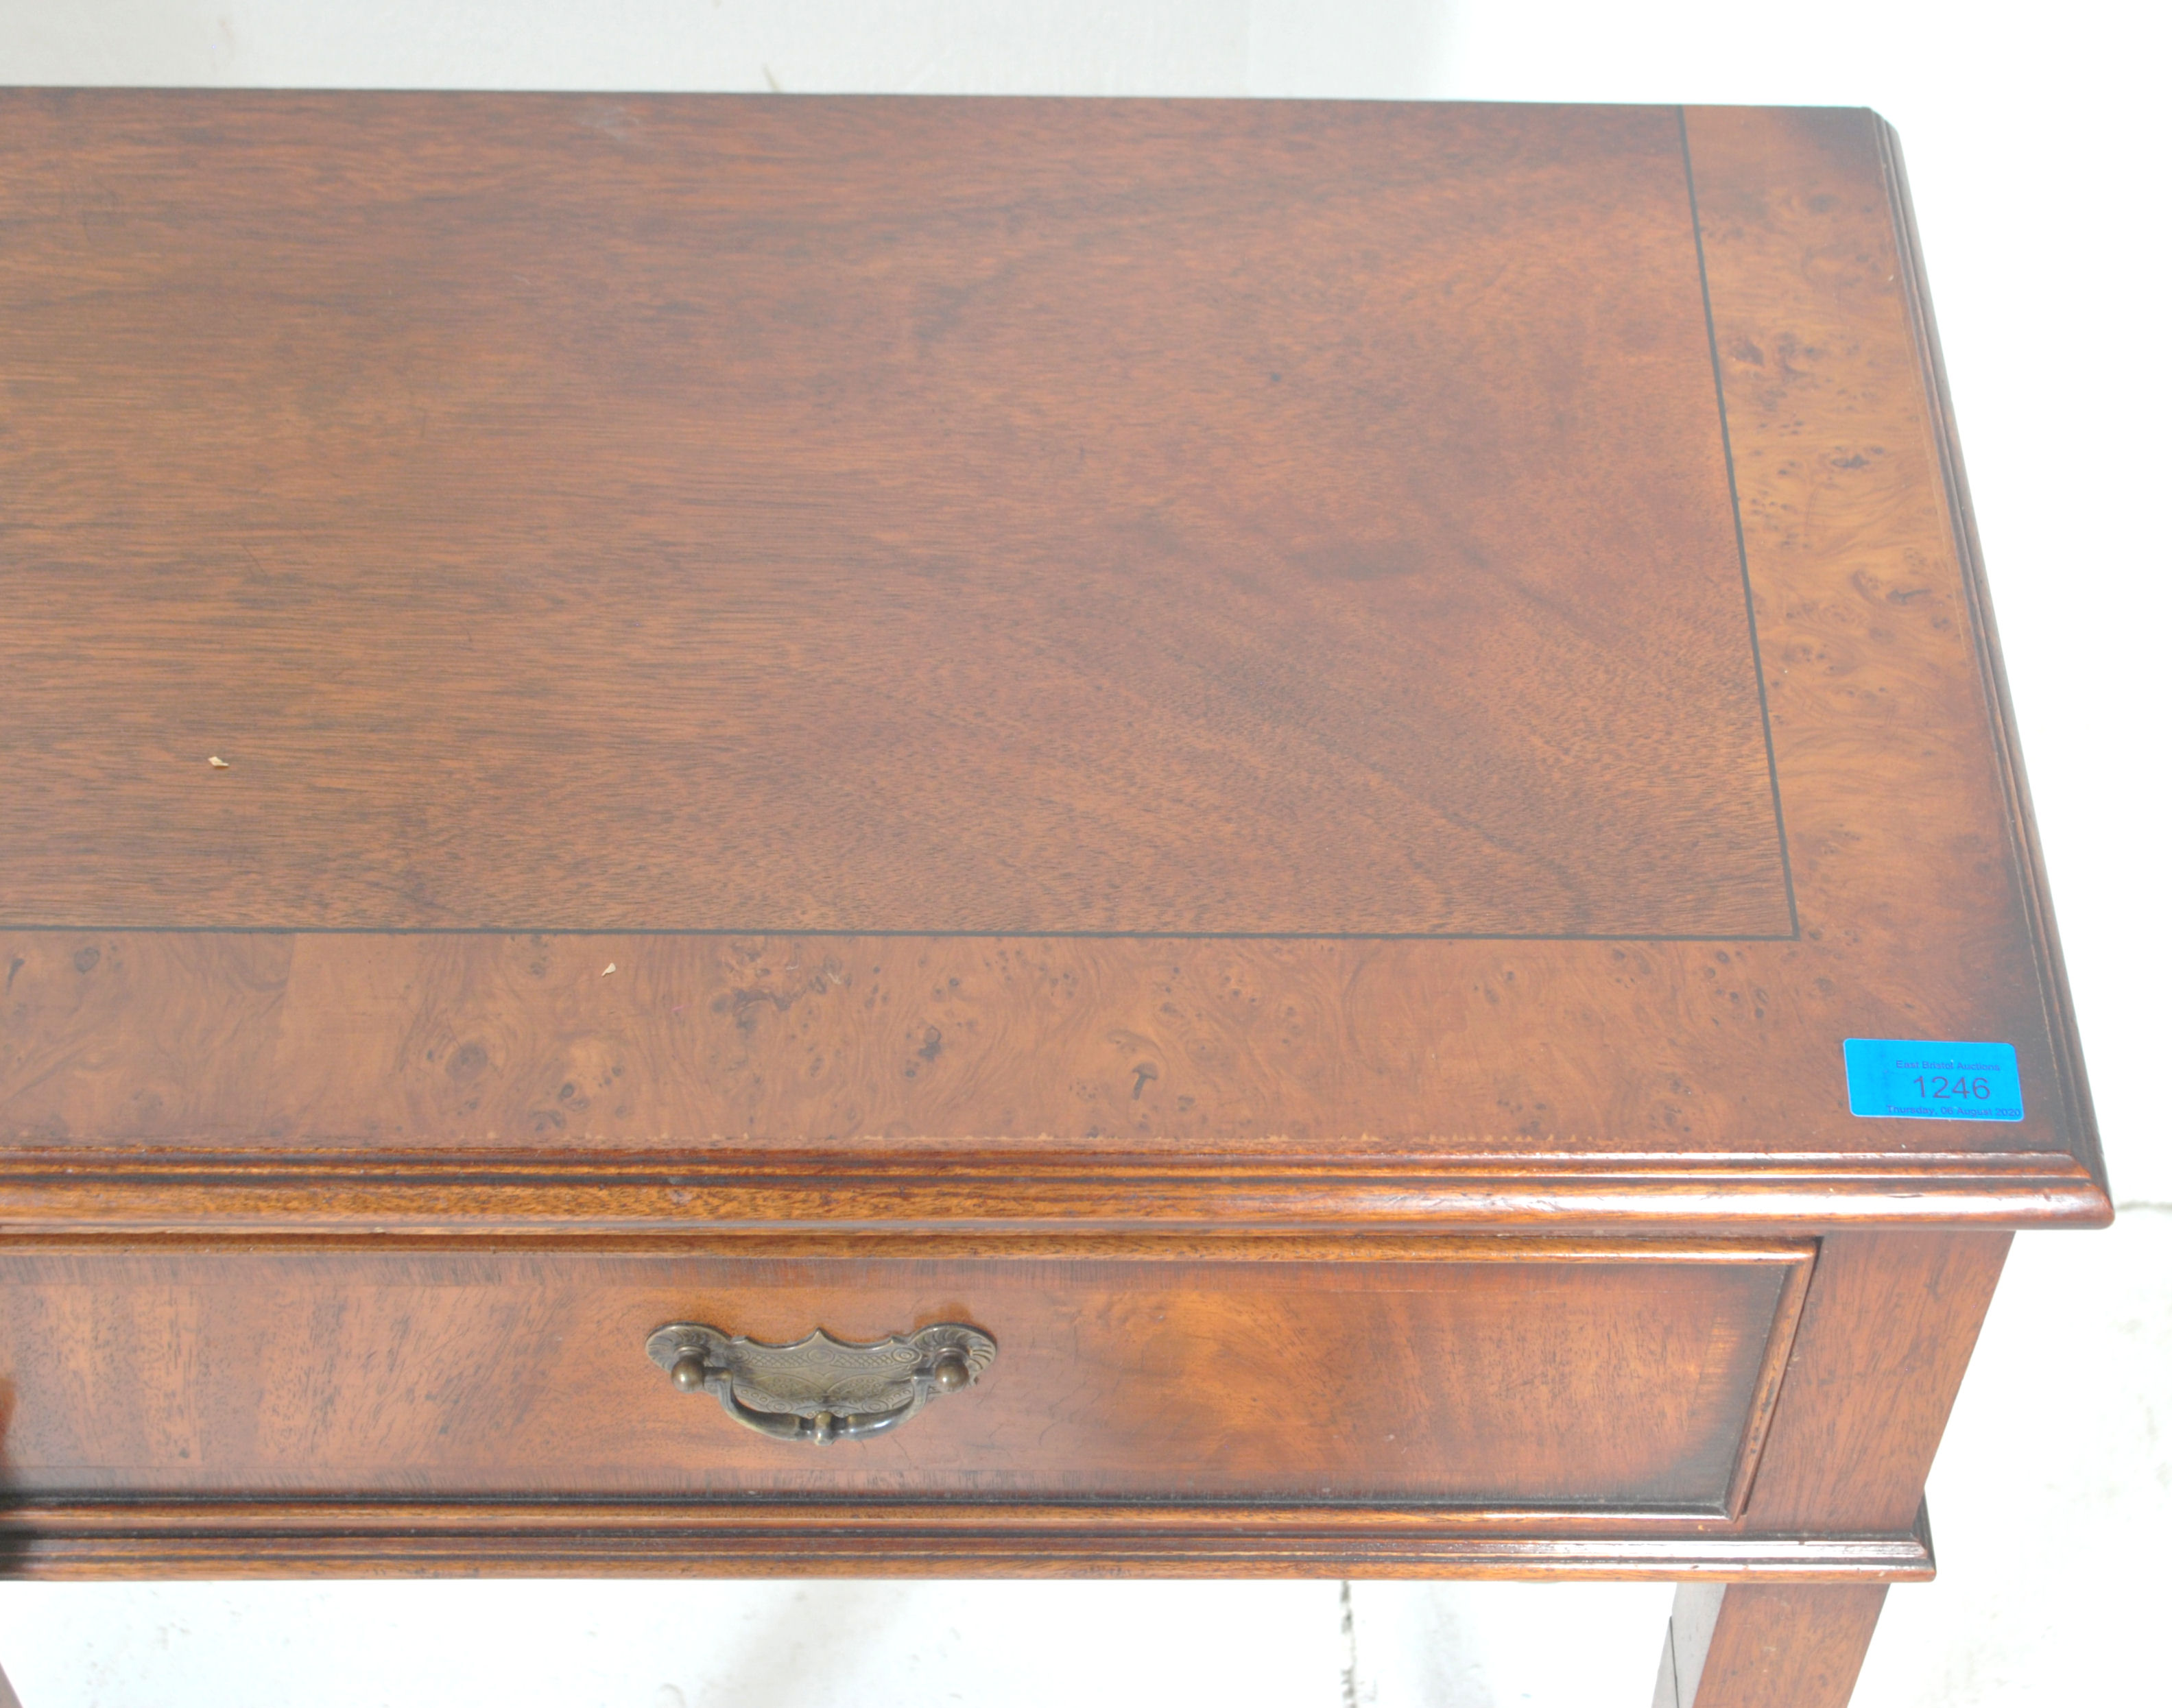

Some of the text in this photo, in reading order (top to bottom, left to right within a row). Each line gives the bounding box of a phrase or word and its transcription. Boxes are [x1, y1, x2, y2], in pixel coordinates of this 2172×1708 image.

[1896, 1061, 2000, 1071] East Bristol Auctions
[1913, 1076, 1991, 1100] 1246
[1887, 1105, 2020, 1117] Thursday, 06 August 2020
